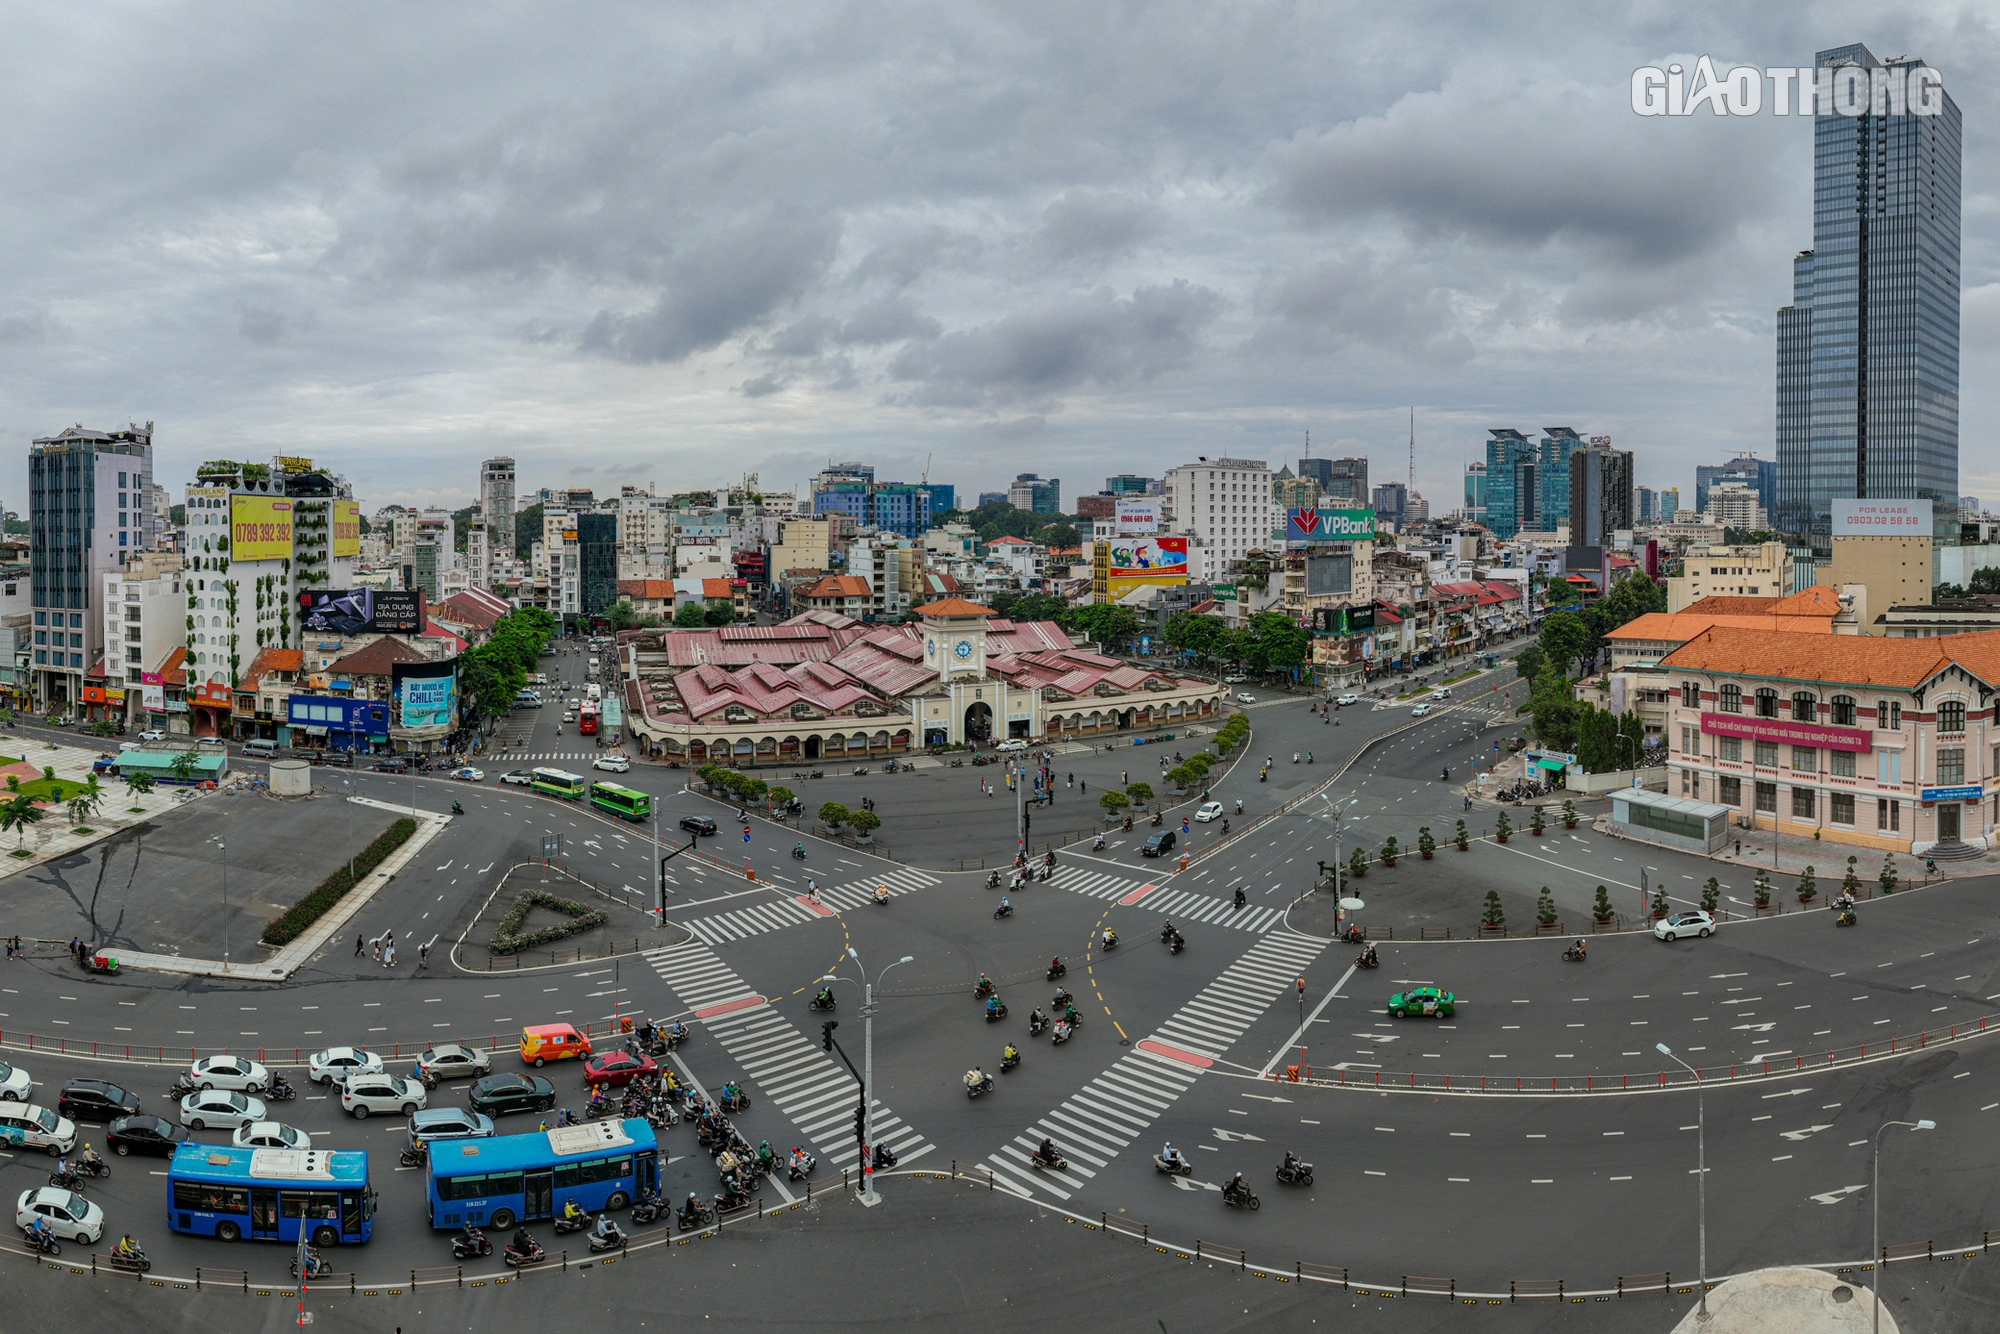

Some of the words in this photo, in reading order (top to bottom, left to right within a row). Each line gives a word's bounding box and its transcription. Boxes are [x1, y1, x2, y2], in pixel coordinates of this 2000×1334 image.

[1824, 55, 1854, 67] Keppel
[187, 488, 226, 496] SILVERLAND
[1322, 515, 1373, 535] VPBank
[1847, 516, 1887, 525] 0903.02
[1890, 517, 1903, 525] 58
[1906, 517, 1919, 525] 58
[235, 523, 258, 543] 0789
[259, 523, 275, 542] 392
[276, 523, 291, 542] 392
[335, 522, 344, 540] 0789
[410, 683, 421, 692] BẬT
[410, 691, 433, 703] CHILL
[1708, 719, 1717, 728] CHỦ
[1717, 721, 1727, 730] TỊCH
[1727, 721, 1734, 730] HỒ
[1734, 722, 1742, 731] CHÍ
[1742, 725, 1753, 733] MINH
[1759, 727, 1767, 737] ĐẠI
[1767, 727, 1779, 736] SỐNG
[1779, 728, 1788, 738] MÃI
[1788, 731, 1804, 739] TRONG
[1804, 731, 1811, 741] SỰ
[1811, 732, 1828, 743] NGHIỆP
[1828, 733, 1838, 743] CỦA
[1838, 734, 1855, 744] CHÚNG
[1855, 737, 1862, 745] TA
